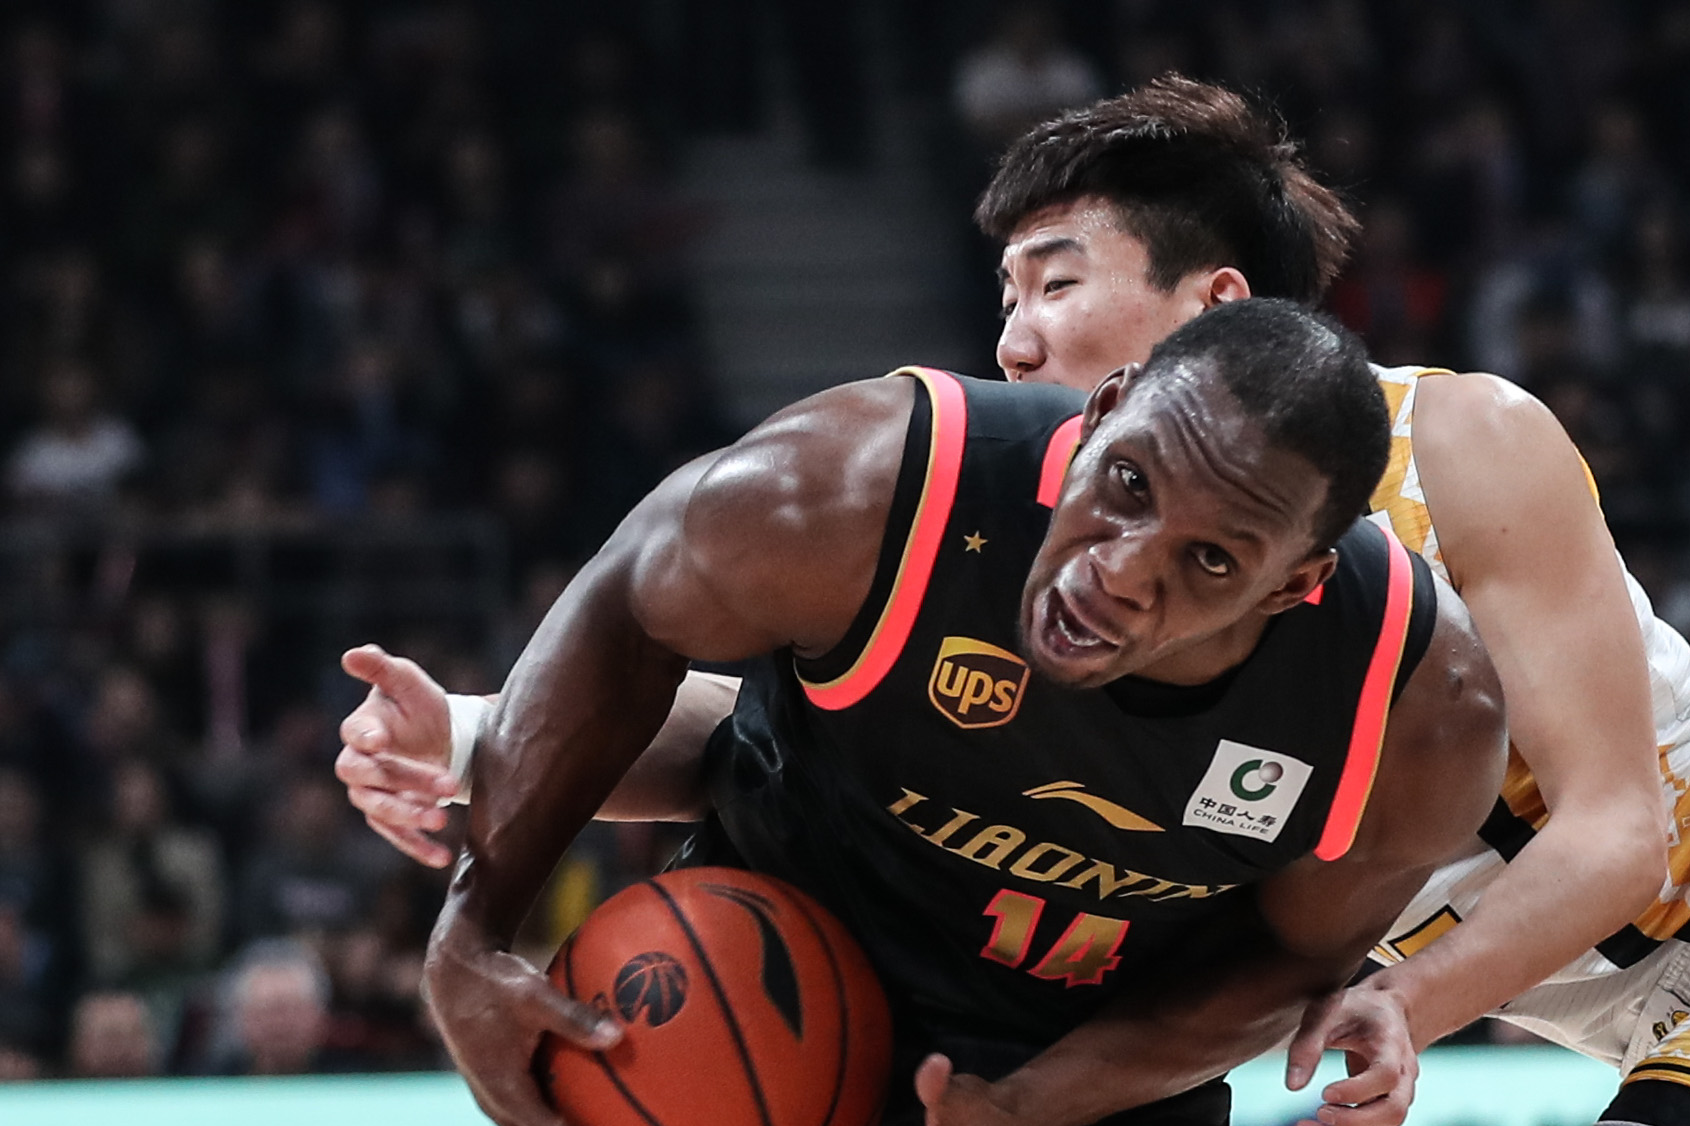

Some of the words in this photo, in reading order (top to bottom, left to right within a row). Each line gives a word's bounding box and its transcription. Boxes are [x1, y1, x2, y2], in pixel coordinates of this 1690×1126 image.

[936, 660, 1018, 715] ups
[1193, 808, 1235, 826] CHINA
[1239, 822, 1269, 835] LIFE
[1199, 797, 1277, 828] 中国人寿
[886, 786, 1241, 902] LIAONIN
[980, 888, 1131, 989] 14
